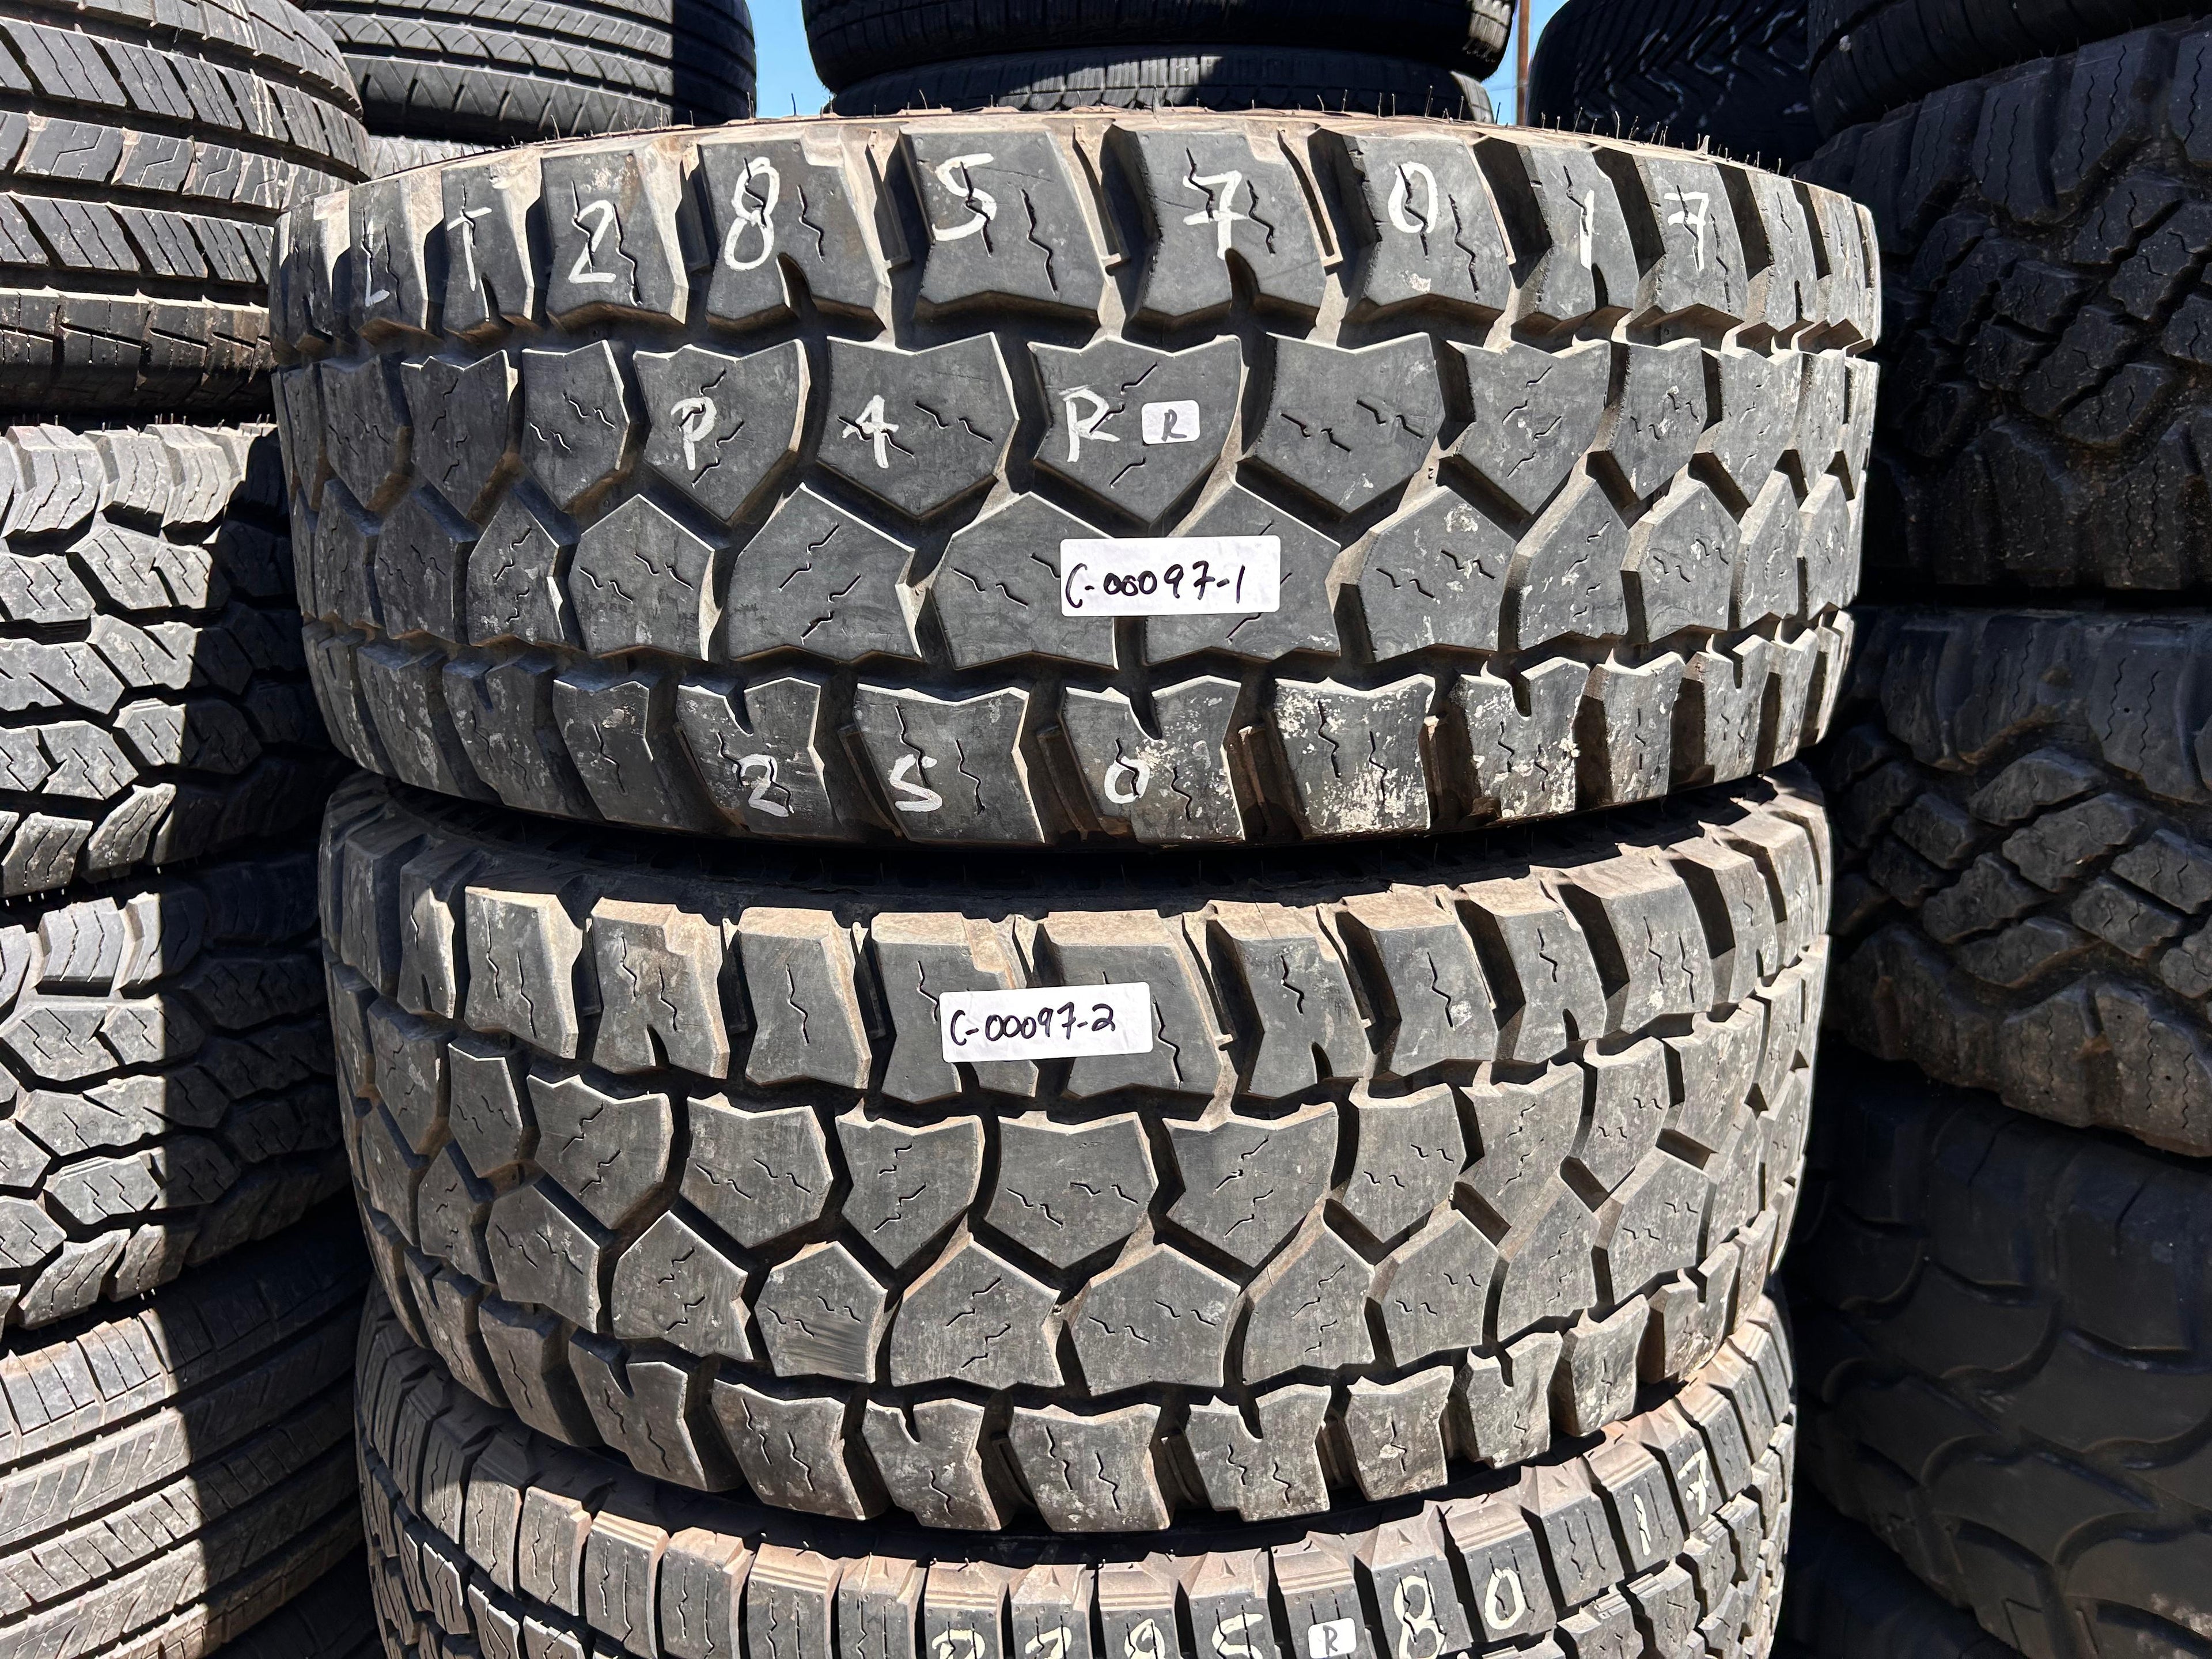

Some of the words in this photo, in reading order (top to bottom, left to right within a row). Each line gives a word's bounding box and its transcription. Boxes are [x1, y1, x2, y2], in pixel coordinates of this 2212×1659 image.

[1161, 408, 1187, 442] R
[1065, 560, 1245, 608] C-00097-1
[950, 1001, 1115, 1046] C-00097-2
[1323, 1624, 1338, 1657] R
